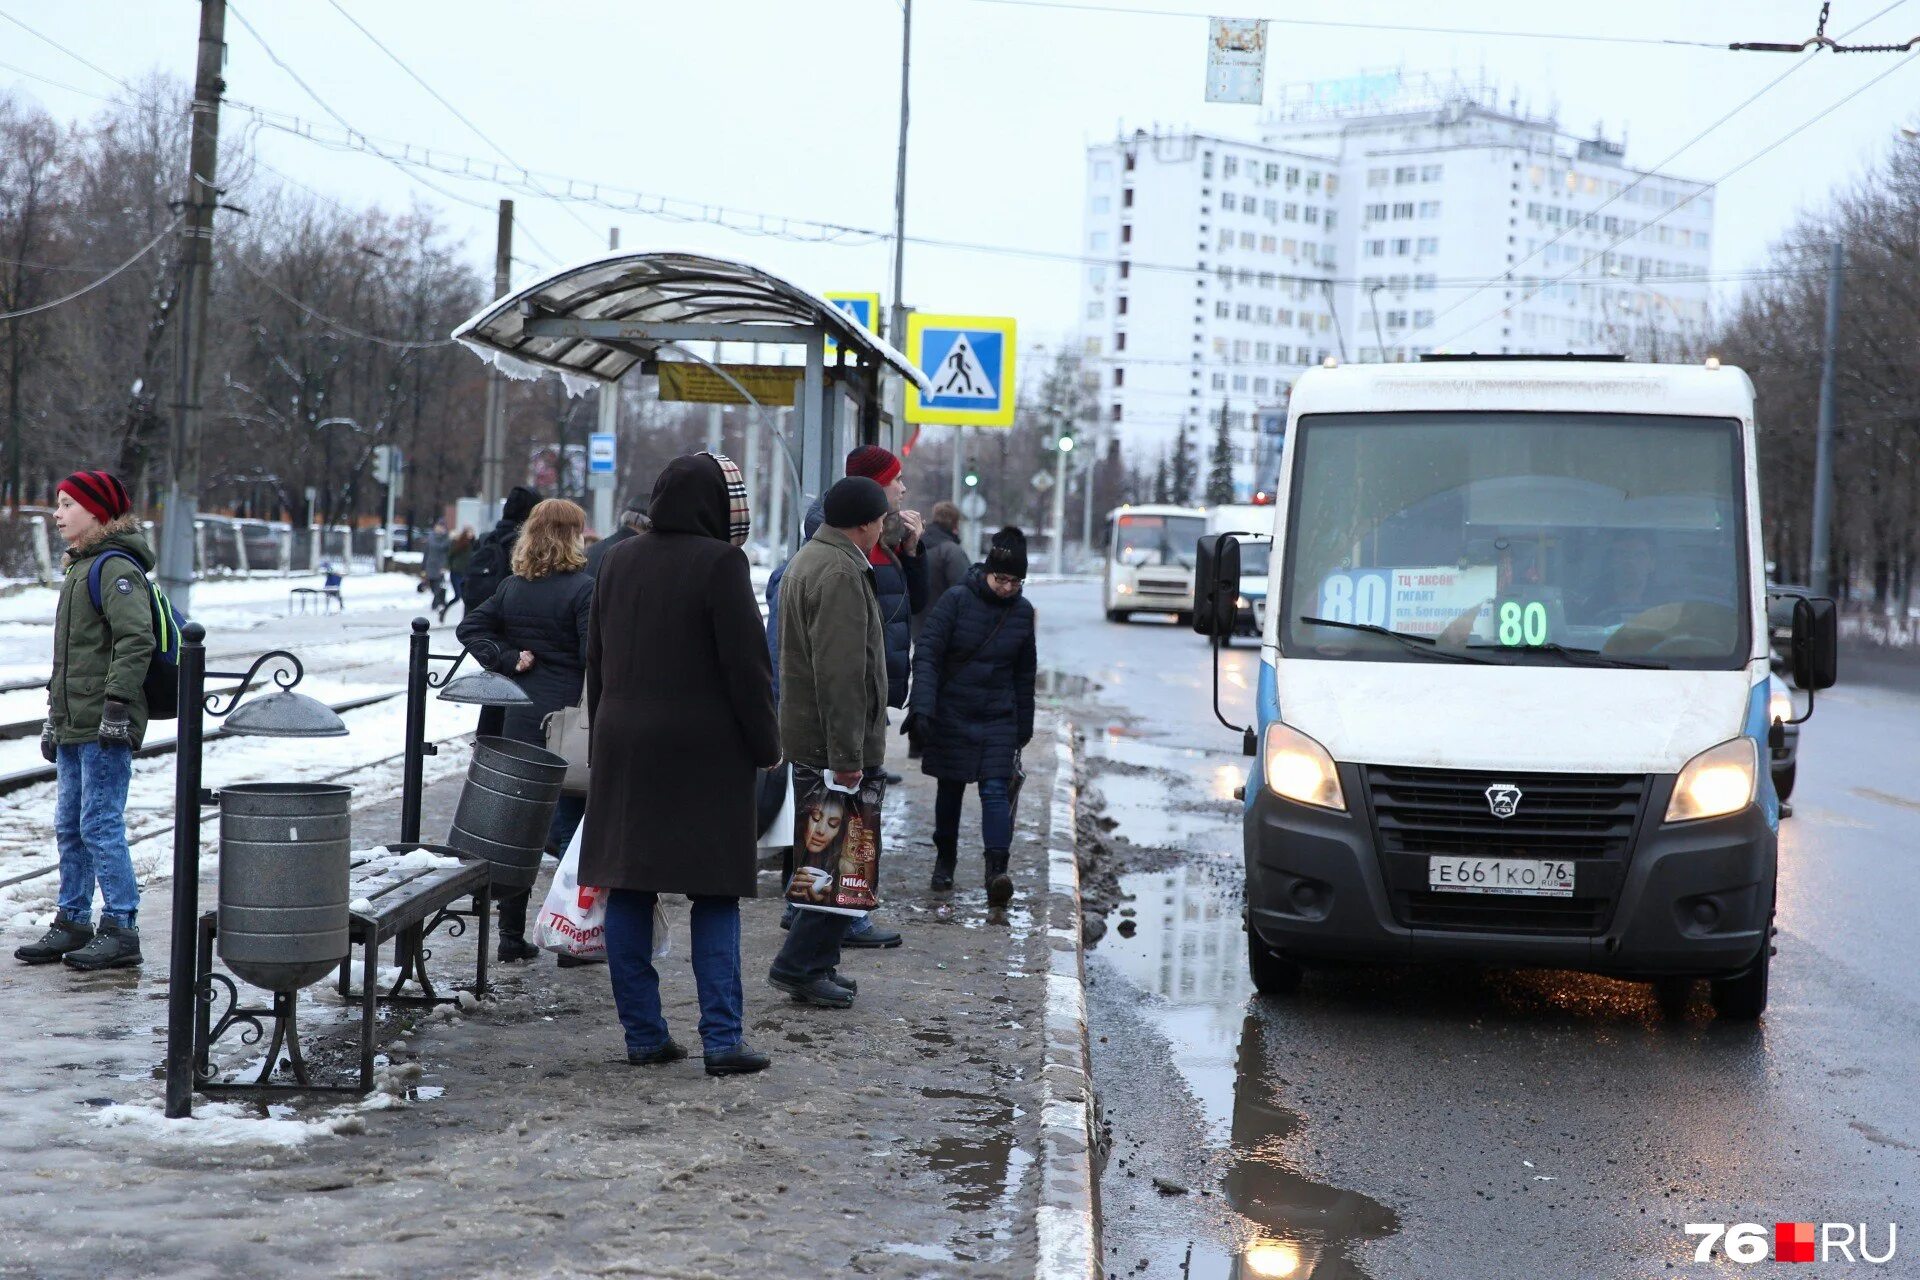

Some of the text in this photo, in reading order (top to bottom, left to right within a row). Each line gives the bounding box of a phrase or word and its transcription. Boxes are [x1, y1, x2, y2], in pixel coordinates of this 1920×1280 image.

[1398, 575, 1411, 588] ТЦ
[1322, 574, 1386, 626] 80
[1416, 606, 1490, 617] Богоявля
[1499, 602, 1547, 646] 80
[1440, 861, 1567, 885] Е661КО 76
